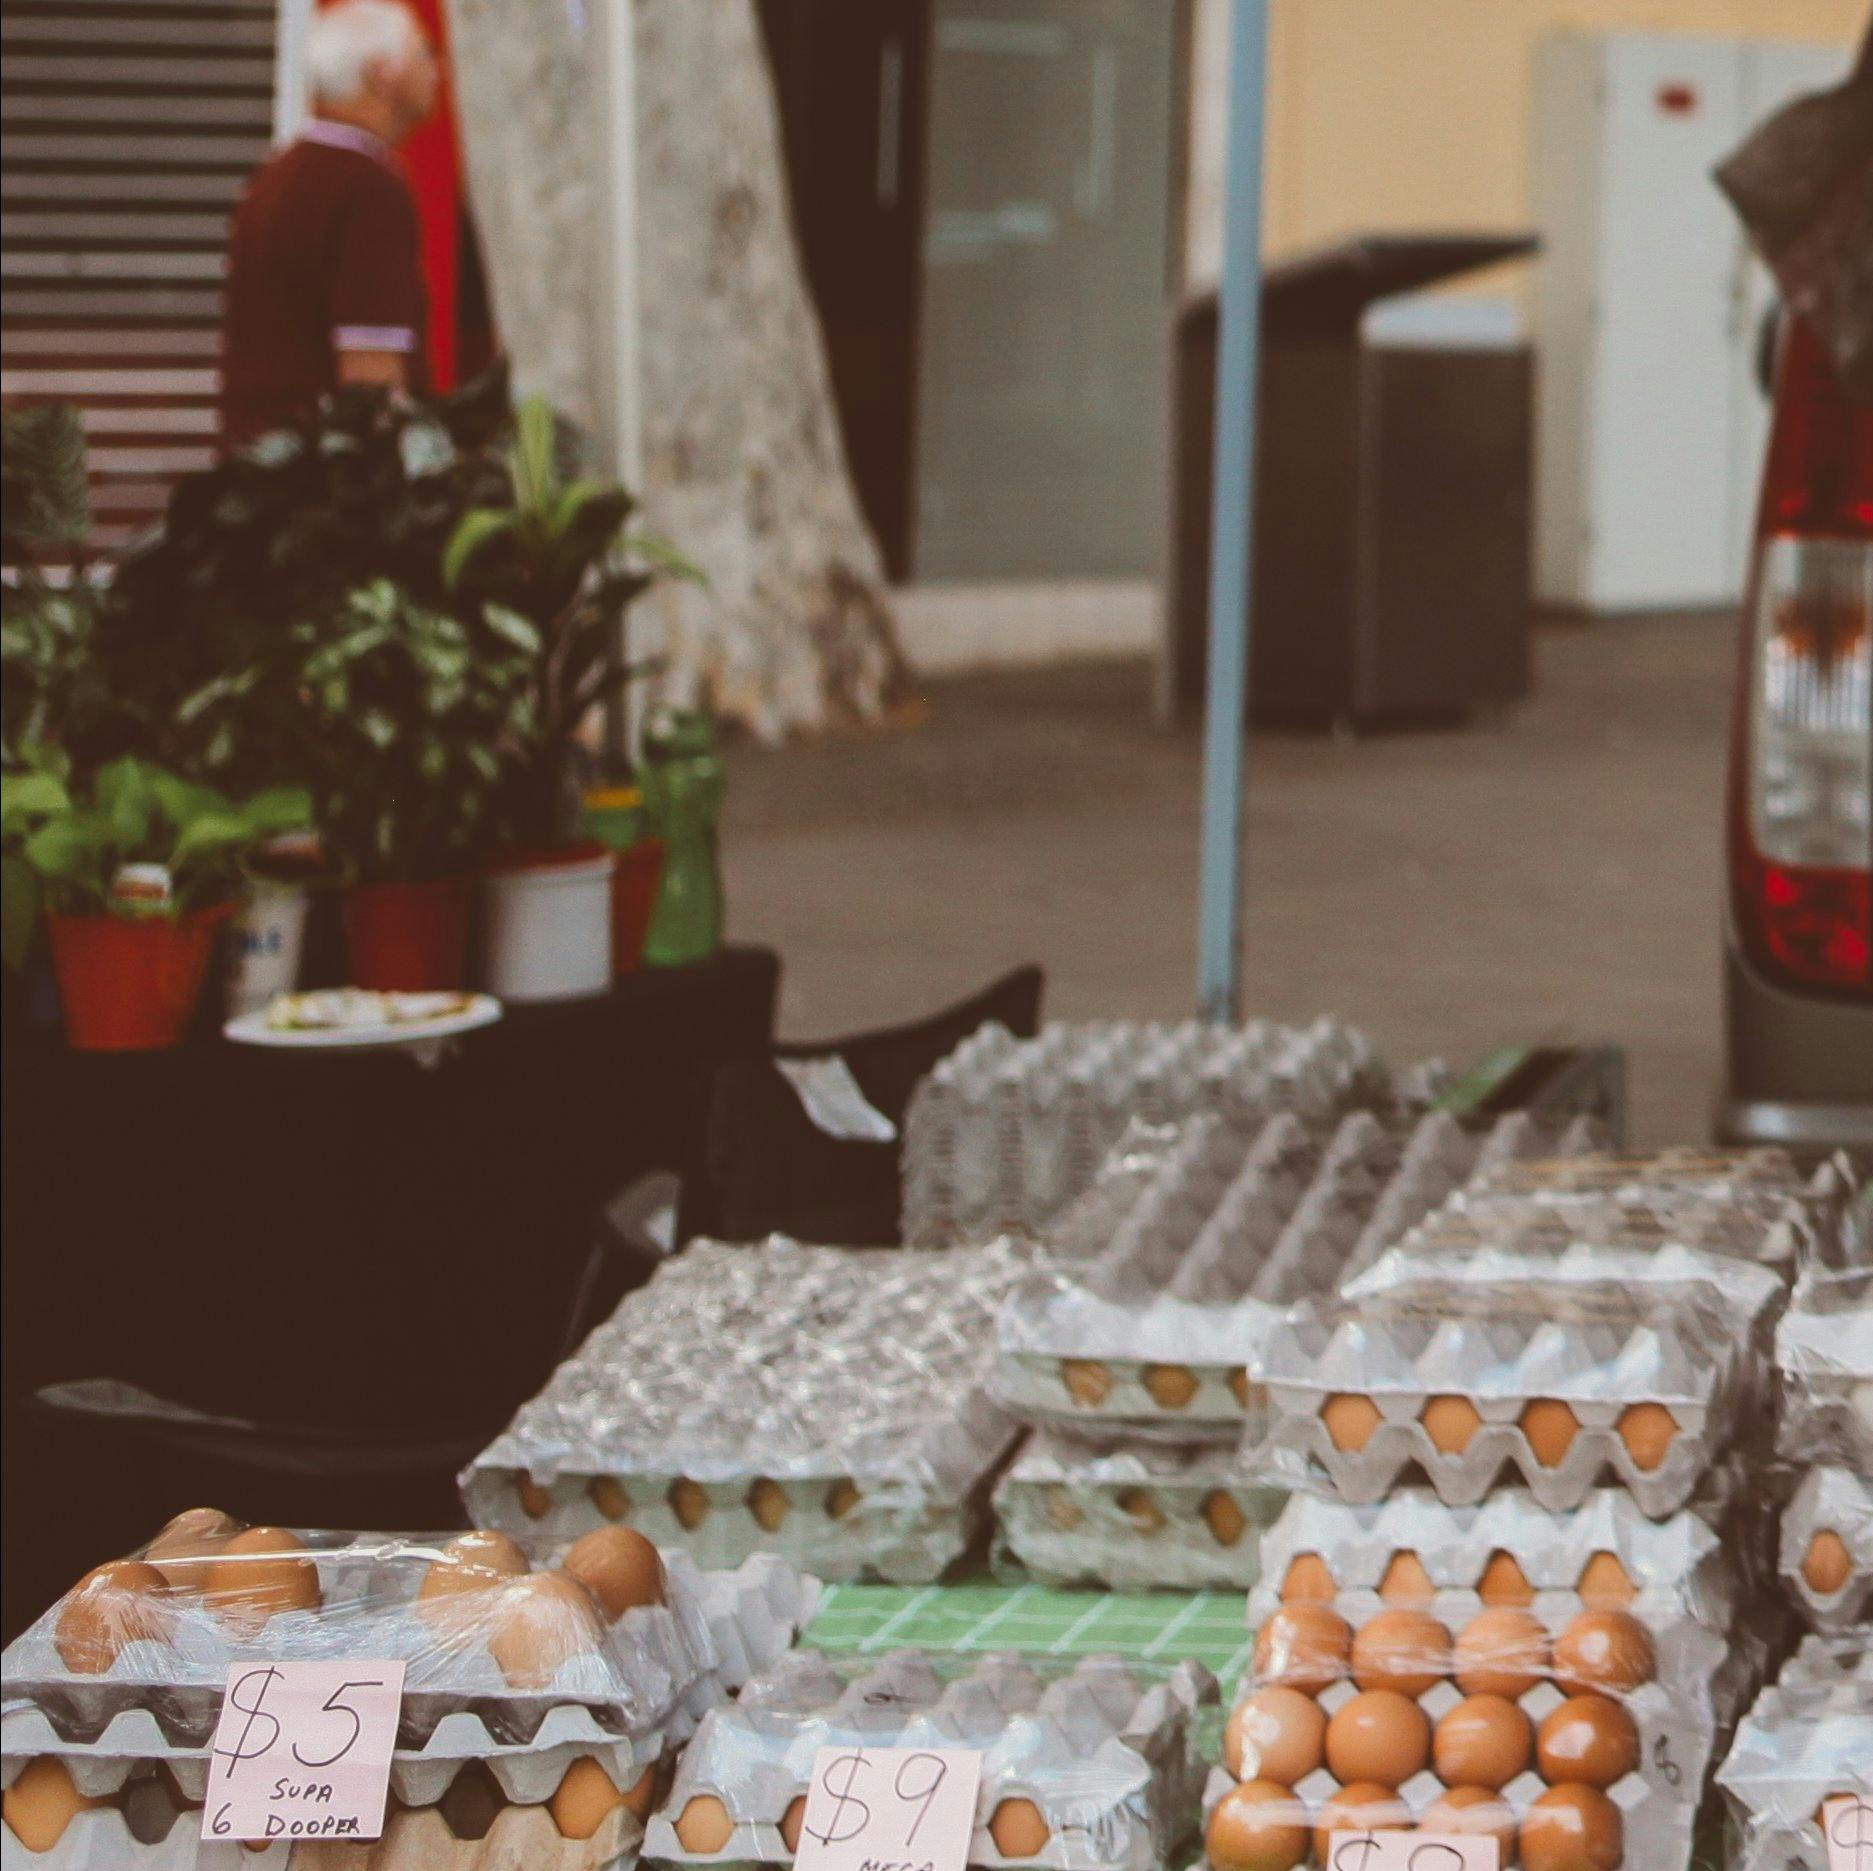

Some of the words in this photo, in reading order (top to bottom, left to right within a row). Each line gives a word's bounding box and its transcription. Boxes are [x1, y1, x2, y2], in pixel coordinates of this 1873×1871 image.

[212, 1665, 384, 1780] $5
[212, 1803, 232, 1835] 6
[265, 1815, 361, 1836] DOOPER
[270, 1778, 333, 1803] SUPA
[804, 1747, 949, 1848] $9
